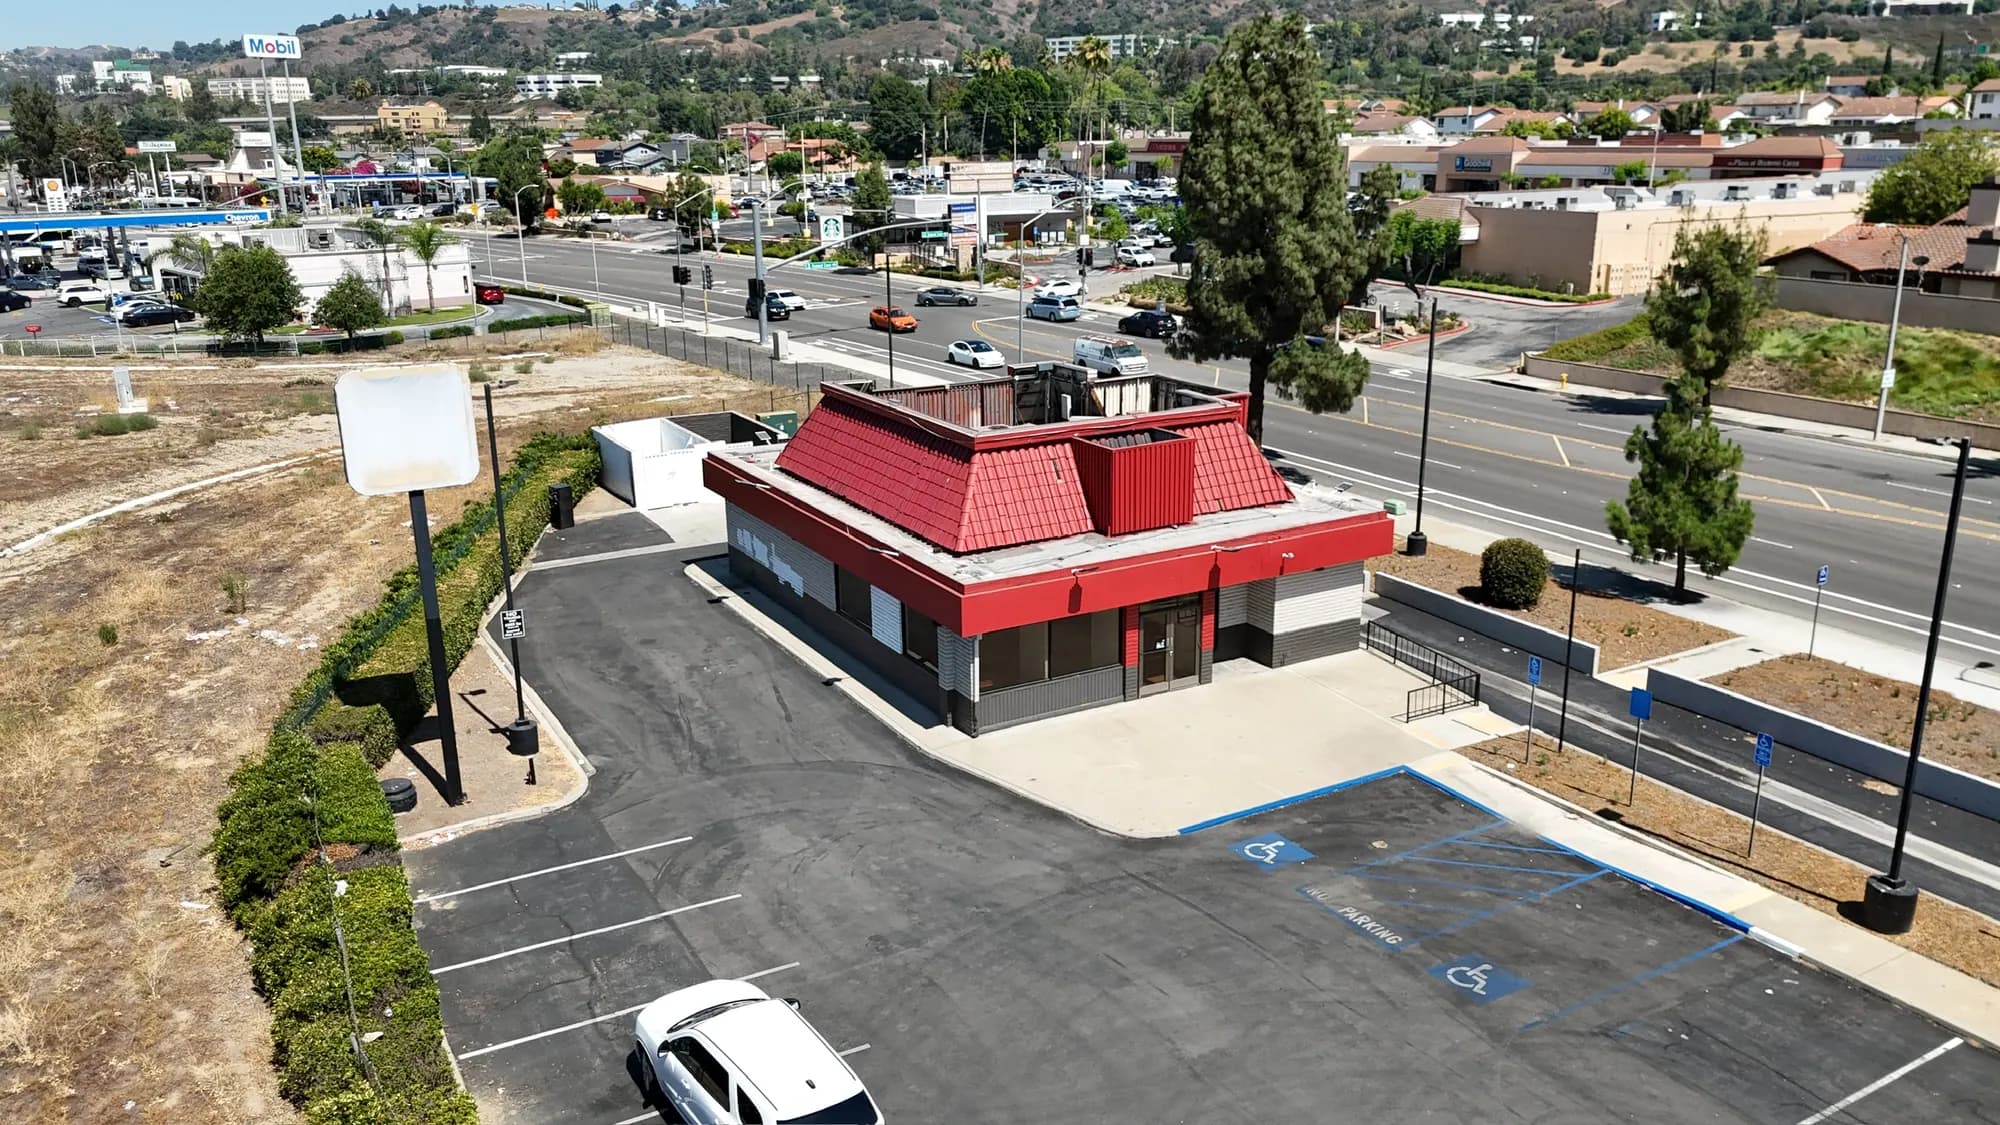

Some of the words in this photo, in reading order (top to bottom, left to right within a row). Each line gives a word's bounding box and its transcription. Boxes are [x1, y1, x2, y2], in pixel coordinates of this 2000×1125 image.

[249, 38, 296, 54] Mobil
[224, 214, 260, 222] Chevron
[1338, 906, 1403, 945] PARKING
